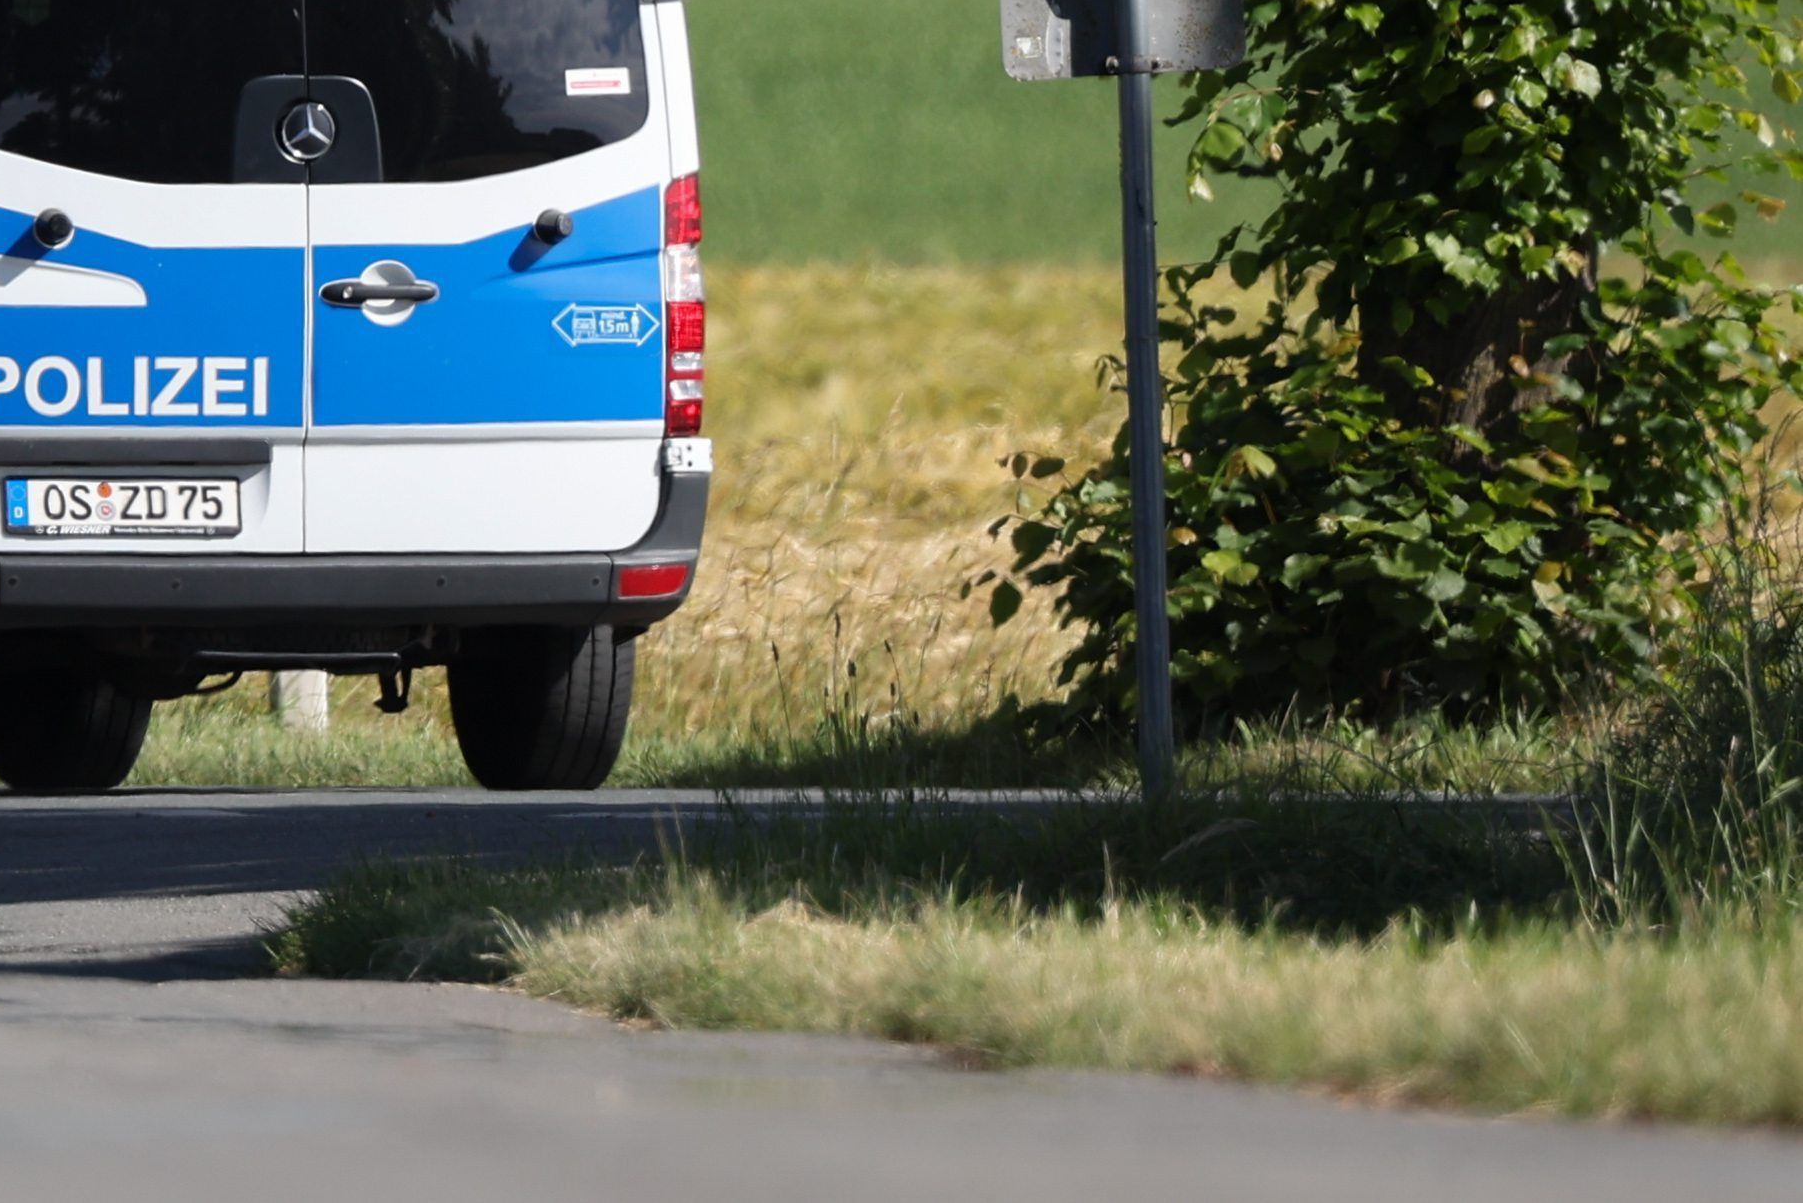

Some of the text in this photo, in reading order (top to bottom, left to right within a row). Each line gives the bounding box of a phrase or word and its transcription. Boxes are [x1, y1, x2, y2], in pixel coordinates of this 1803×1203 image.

[43, 484, 223, 521] OS ZD 75
[14, 506, 24, 518] D
[59, 525, 112, 535] WIESNER
